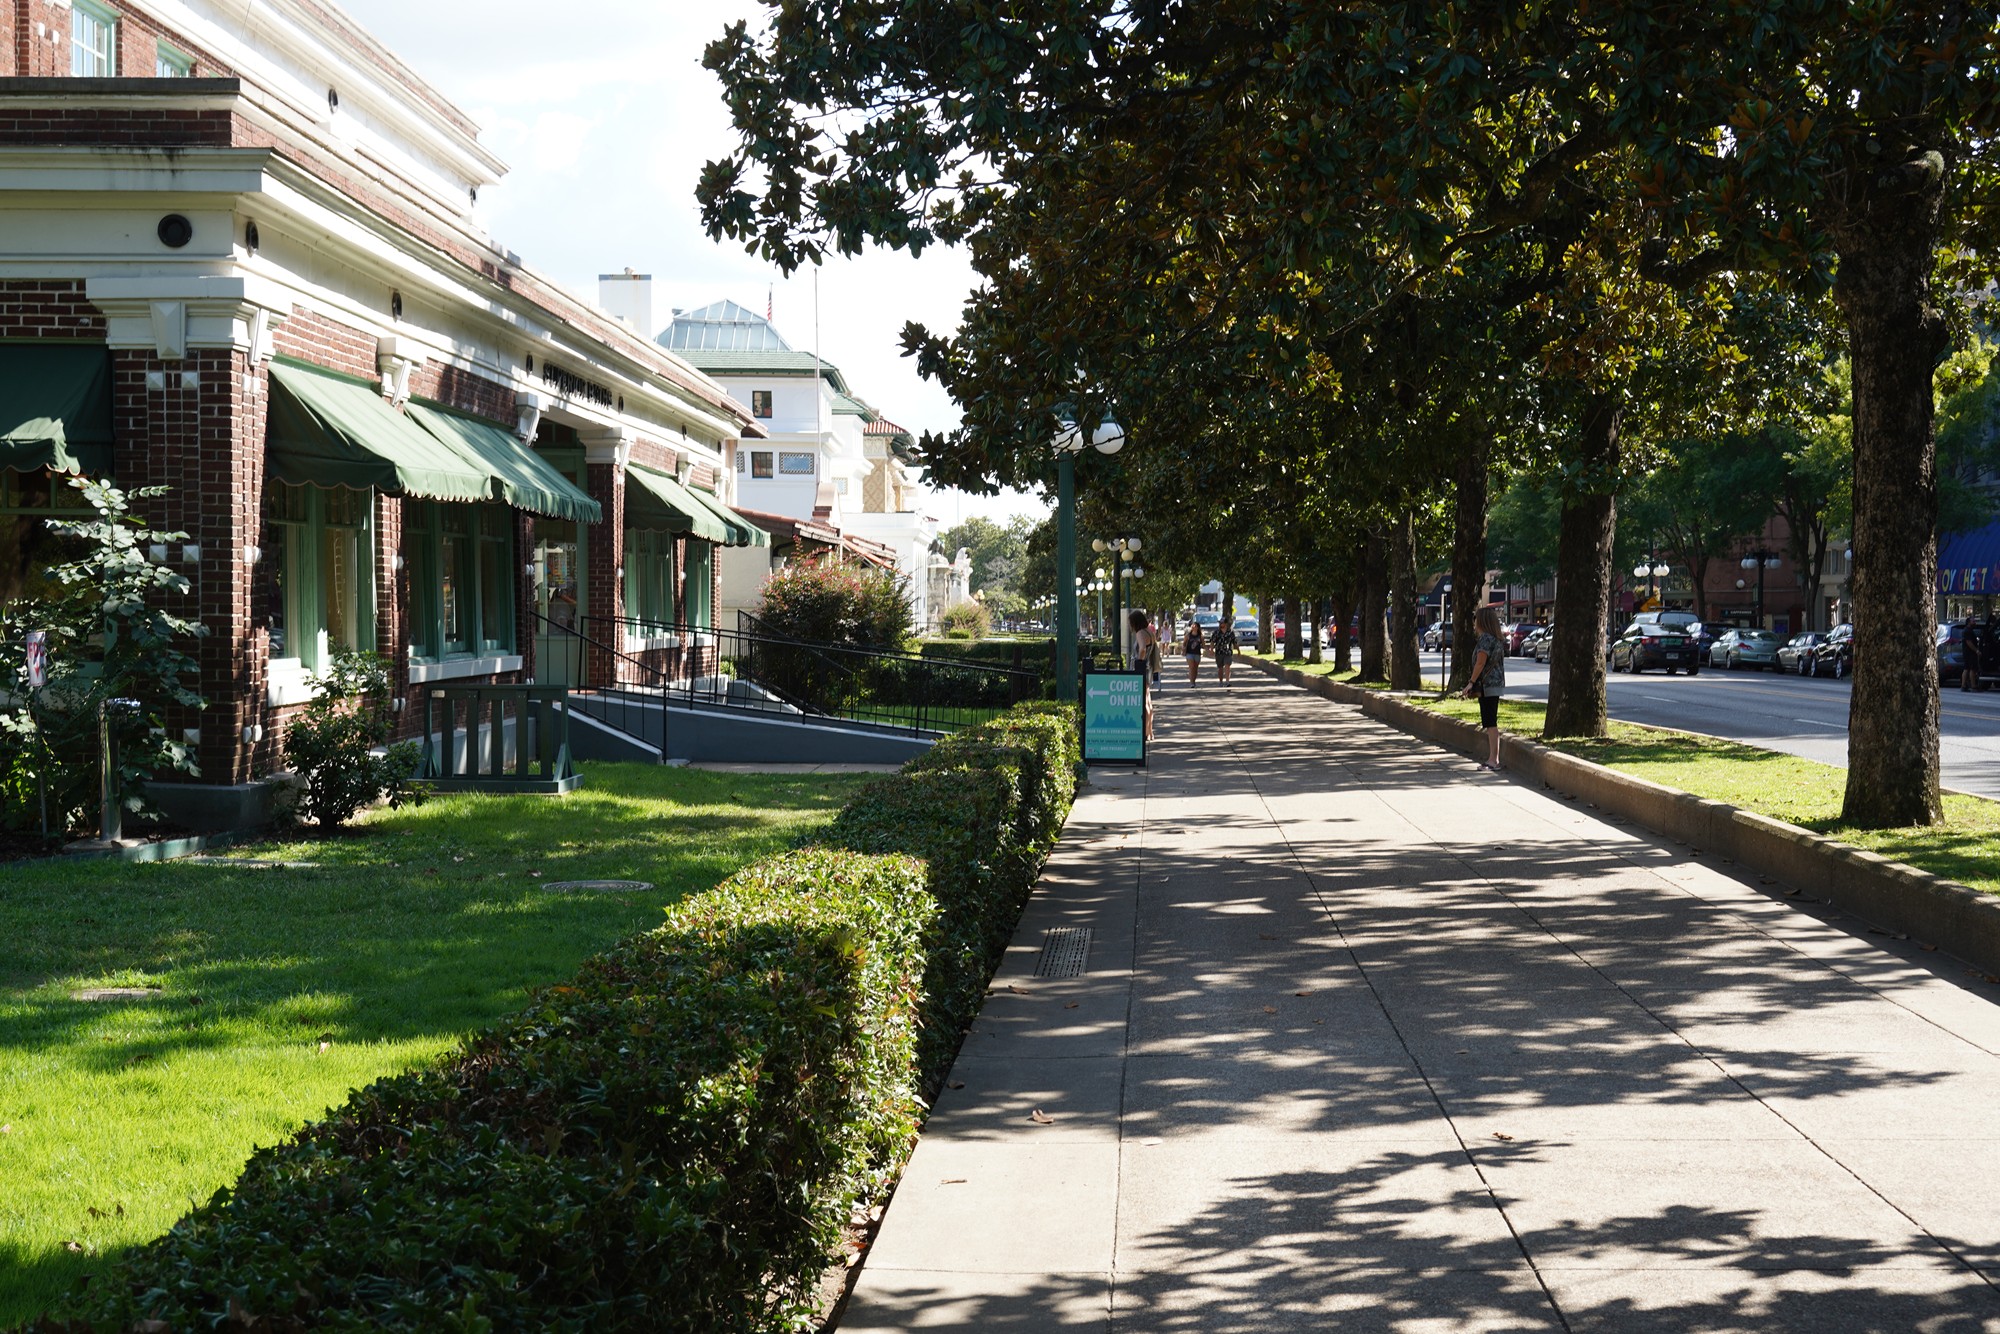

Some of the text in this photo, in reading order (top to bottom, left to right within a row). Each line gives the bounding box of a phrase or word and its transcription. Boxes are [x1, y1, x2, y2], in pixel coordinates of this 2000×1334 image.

[1958, 567, 1988, 592] CHEST
[1109, 680, 1139, 692] COME
[1109, 695, 1142, 707] ON IN!
